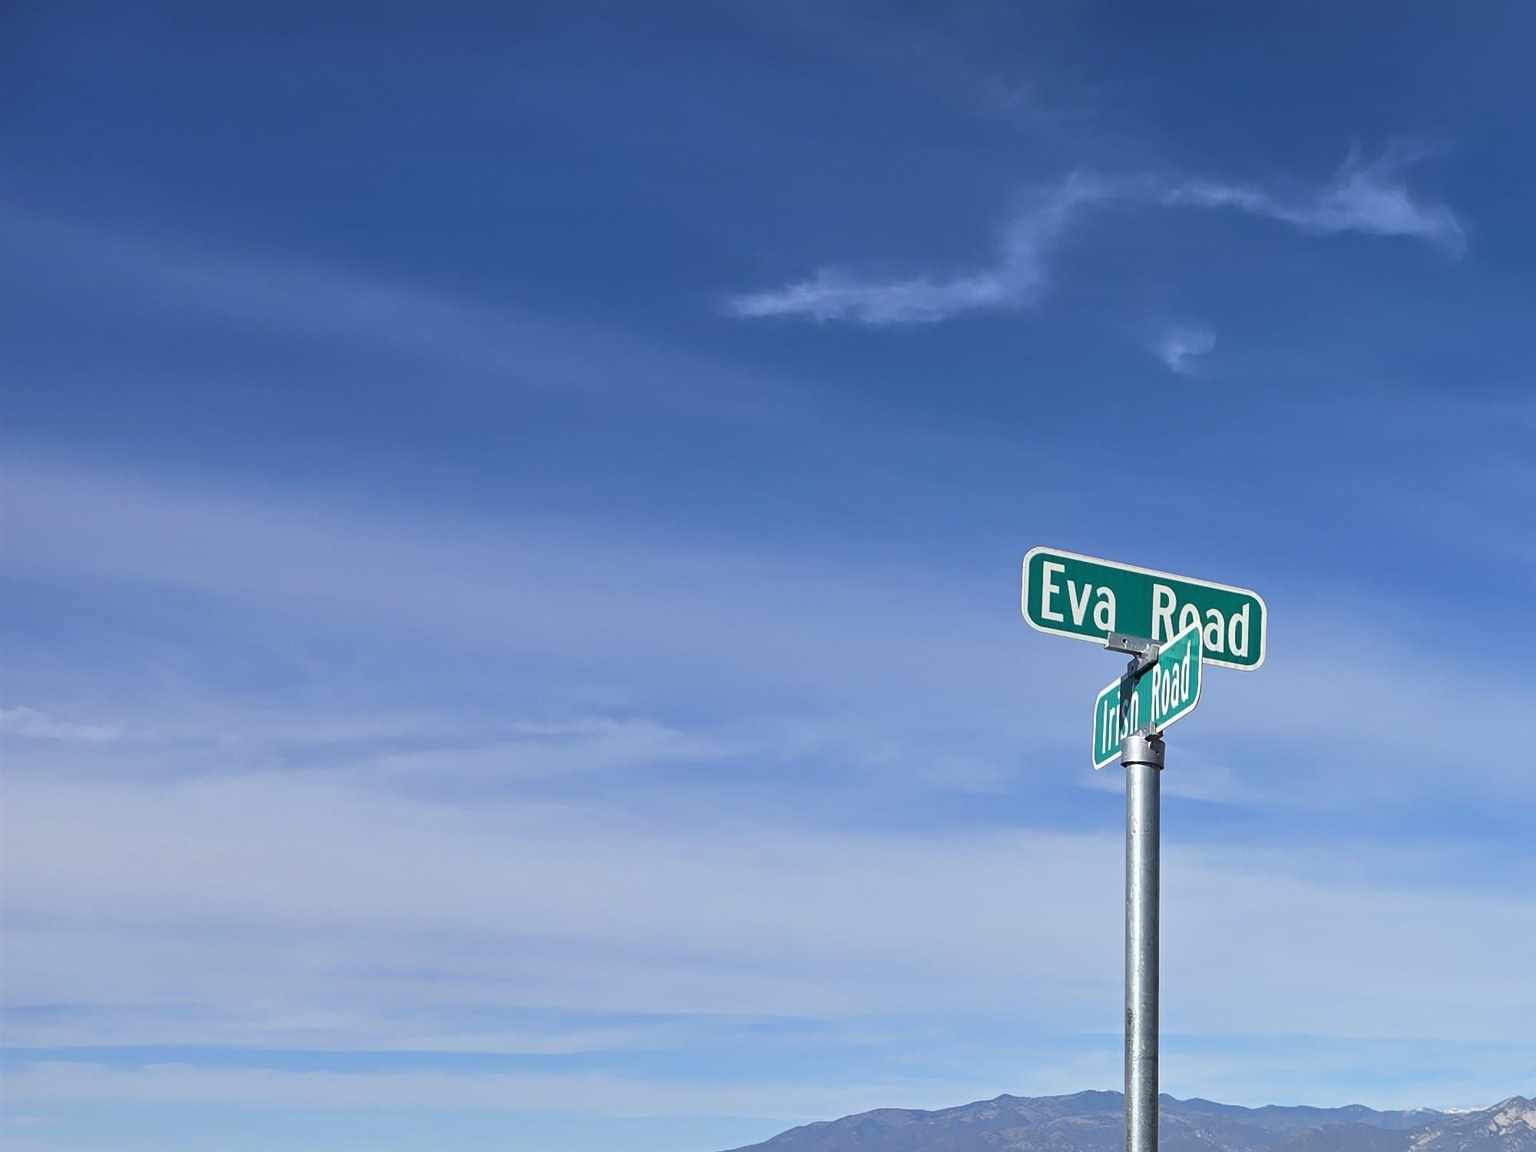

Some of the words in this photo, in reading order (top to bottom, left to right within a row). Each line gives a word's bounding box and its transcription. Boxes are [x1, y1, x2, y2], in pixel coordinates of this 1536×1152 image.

[1042, 561, 1116, 631] Eva
[1151, 584, 1250, 657] Road
[1102, 684, 1139, 753] Irish
[1151, 641, 1191, 721] Road
